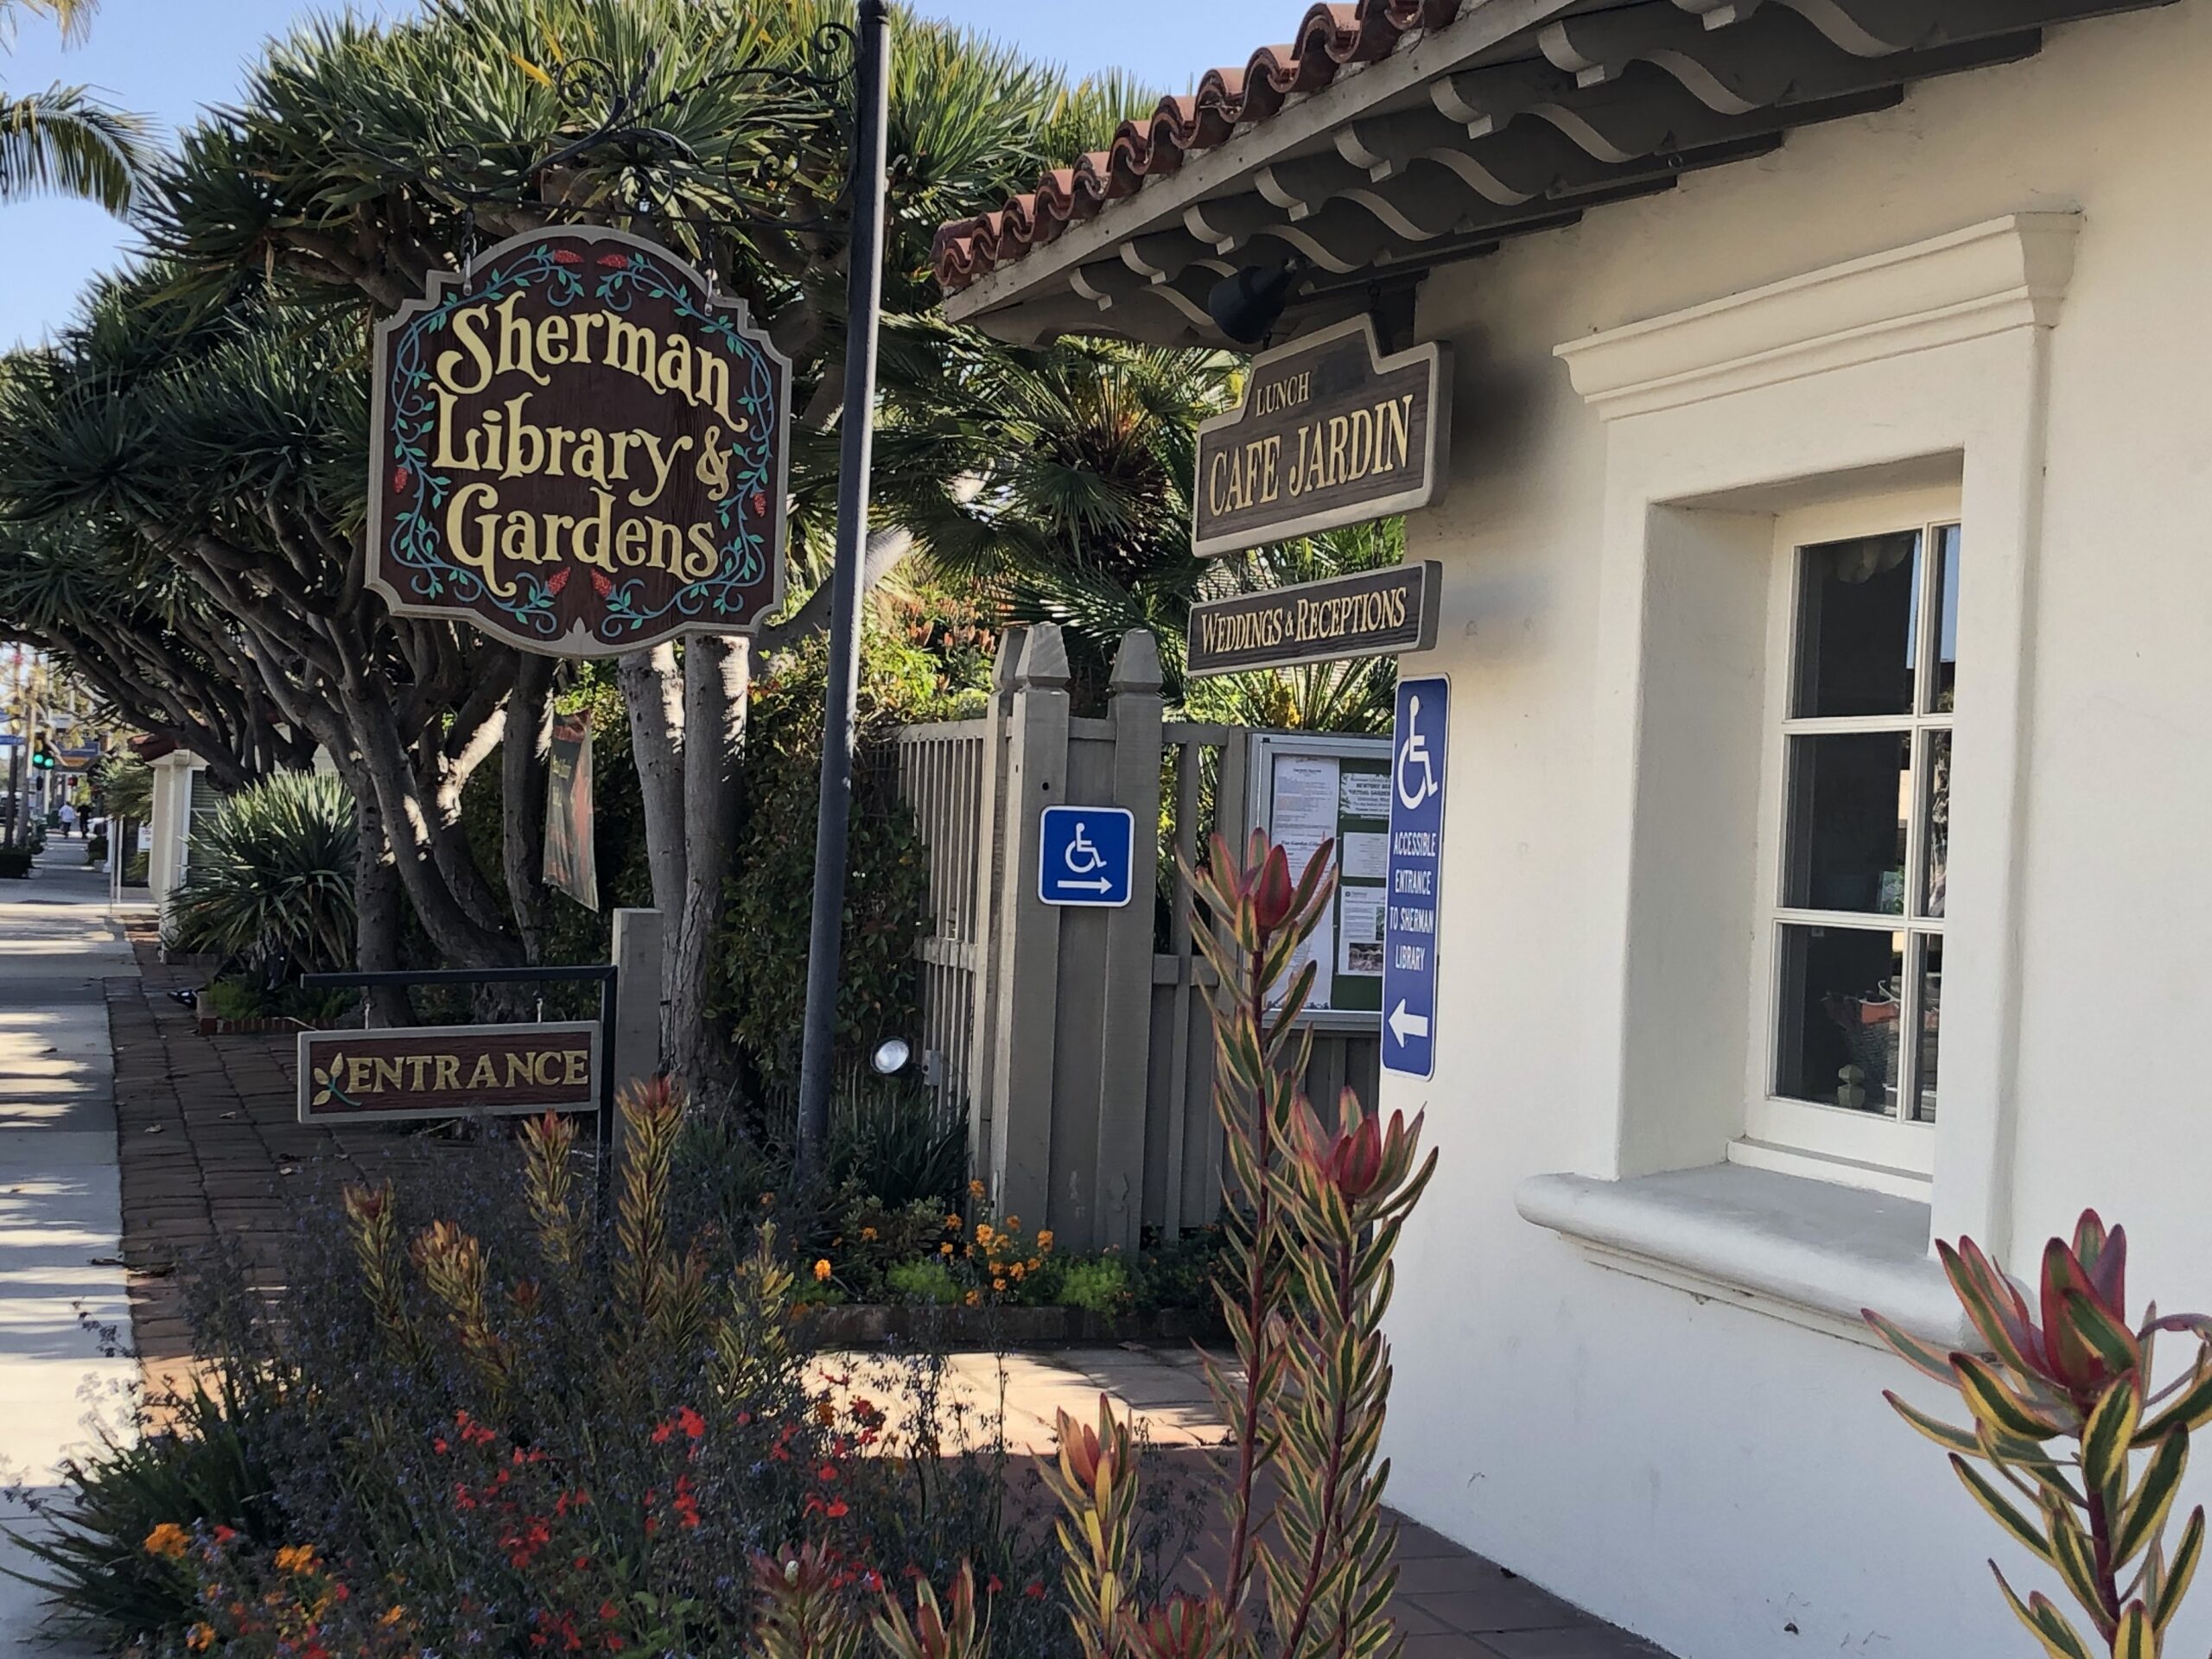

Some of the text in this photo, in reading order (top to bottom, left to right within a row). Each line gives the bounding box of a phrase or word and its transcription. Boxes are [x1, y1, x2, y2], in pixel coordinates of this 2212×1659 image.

[436, 290, 748, 432] Sherman
[1255, 372, 1310, 416] LUNCH
[428, 383, 733, 506] Library &
[1210, 394, 1414, 517] CAFE JARDIN
[446, 483, 719, 597] Gardens
[1285, 610, 1294, 638] &
[1393, 831, 1437, 857] ACCESSIBLE
[1395, 869, 1432, 895] ENTRANCE
[1389, 906, 1398, 931] TO
[1400, 907, 1434, 934] SHERMAN
[1395, 944, 1426, 971] LIBRARY
[345, 1050, 588, 1093] ENTRANCE
